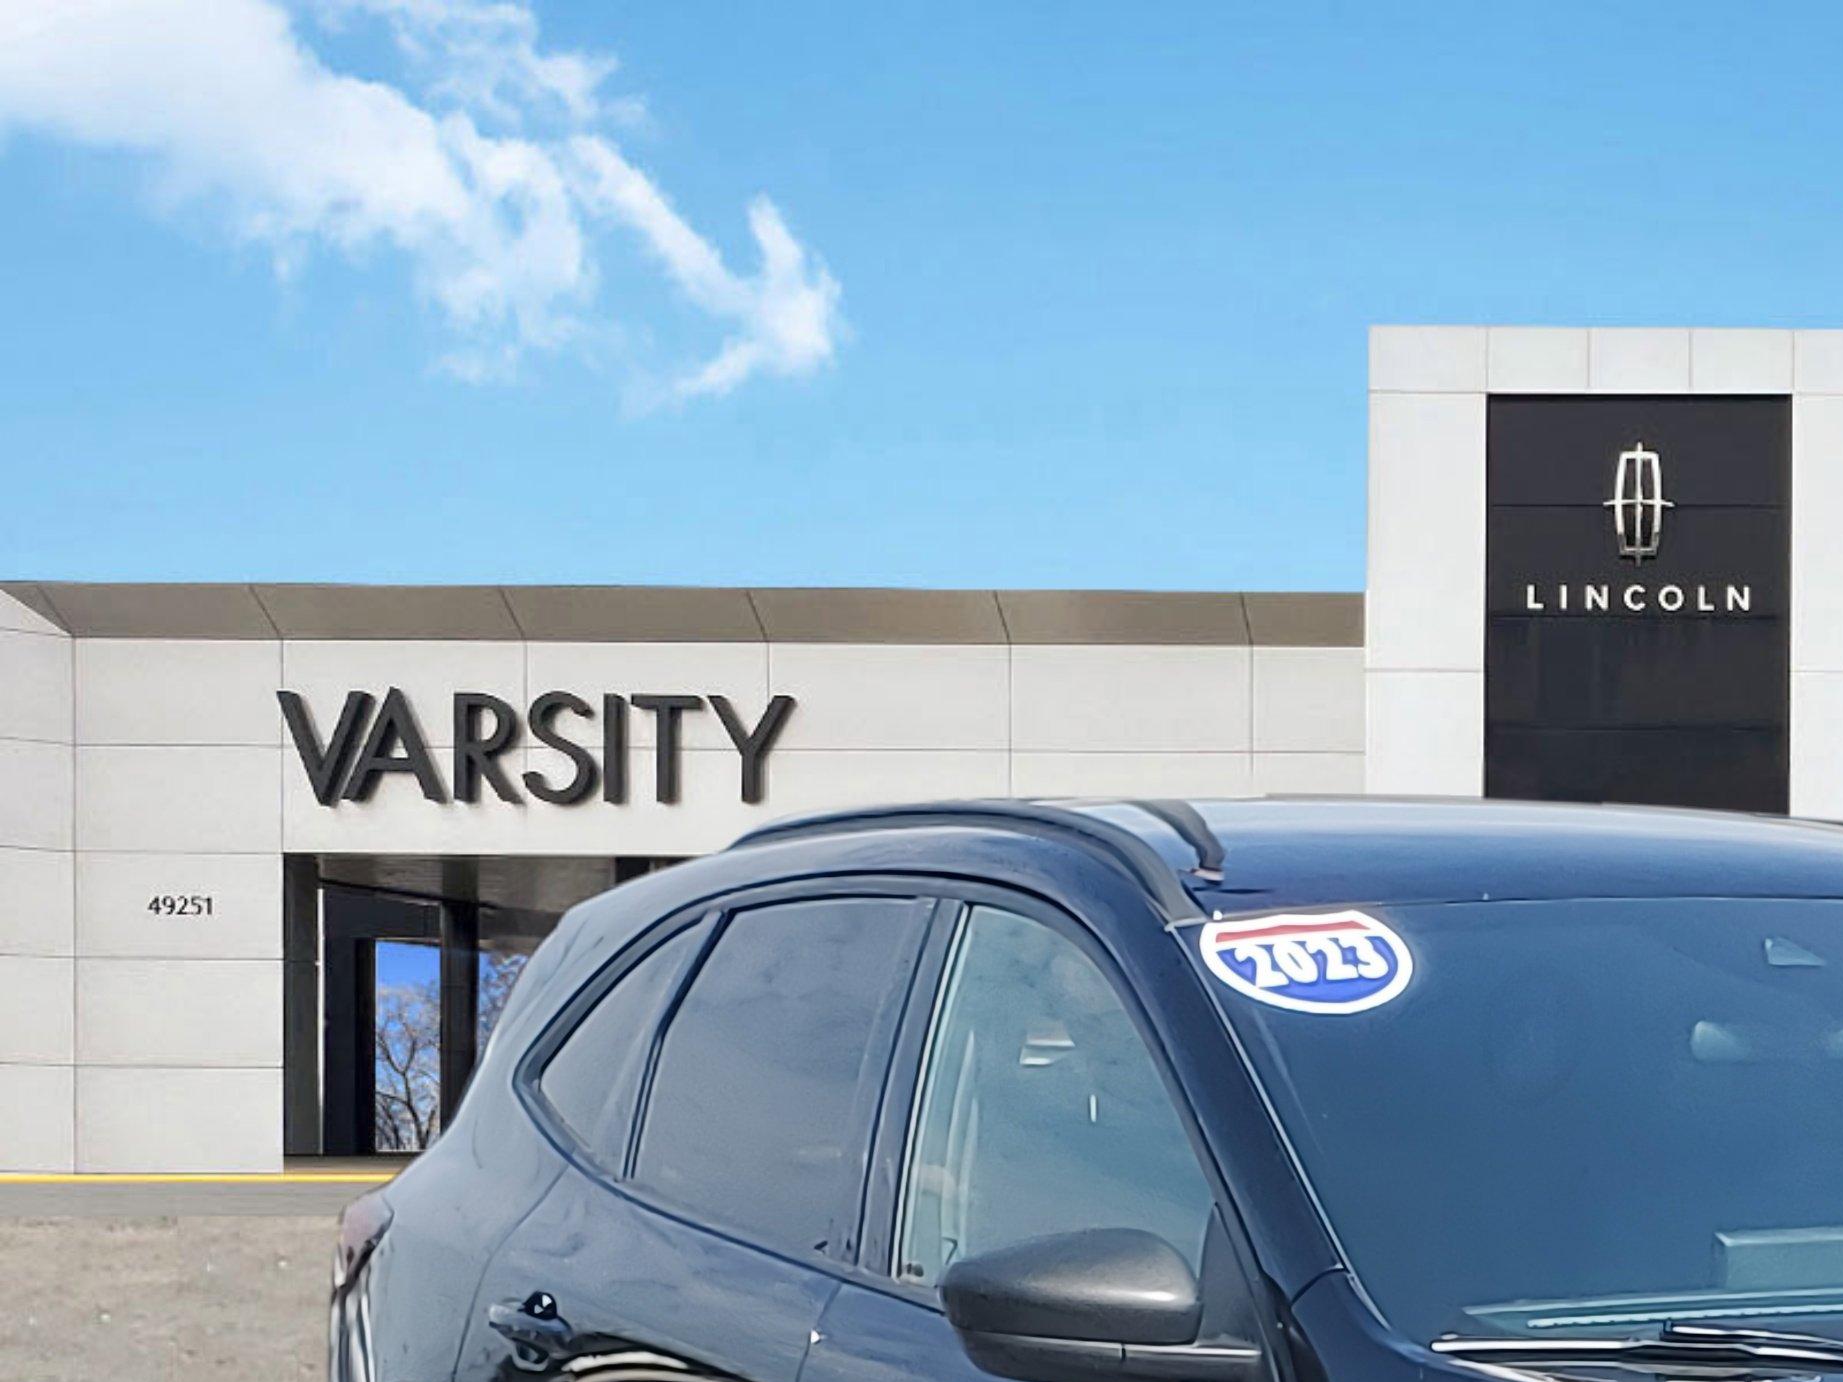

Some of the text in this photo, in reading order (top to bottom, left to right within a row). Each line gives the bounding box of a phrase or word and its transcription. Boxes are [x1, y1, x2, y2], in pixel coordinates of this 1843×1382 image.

[1527, 584, 1752, 611] LINCOLN
[276, 687, 797, 806] VARSITY
[147, 896, 214, 917] 49251
[1234, 936, 1390, 988] 2023
